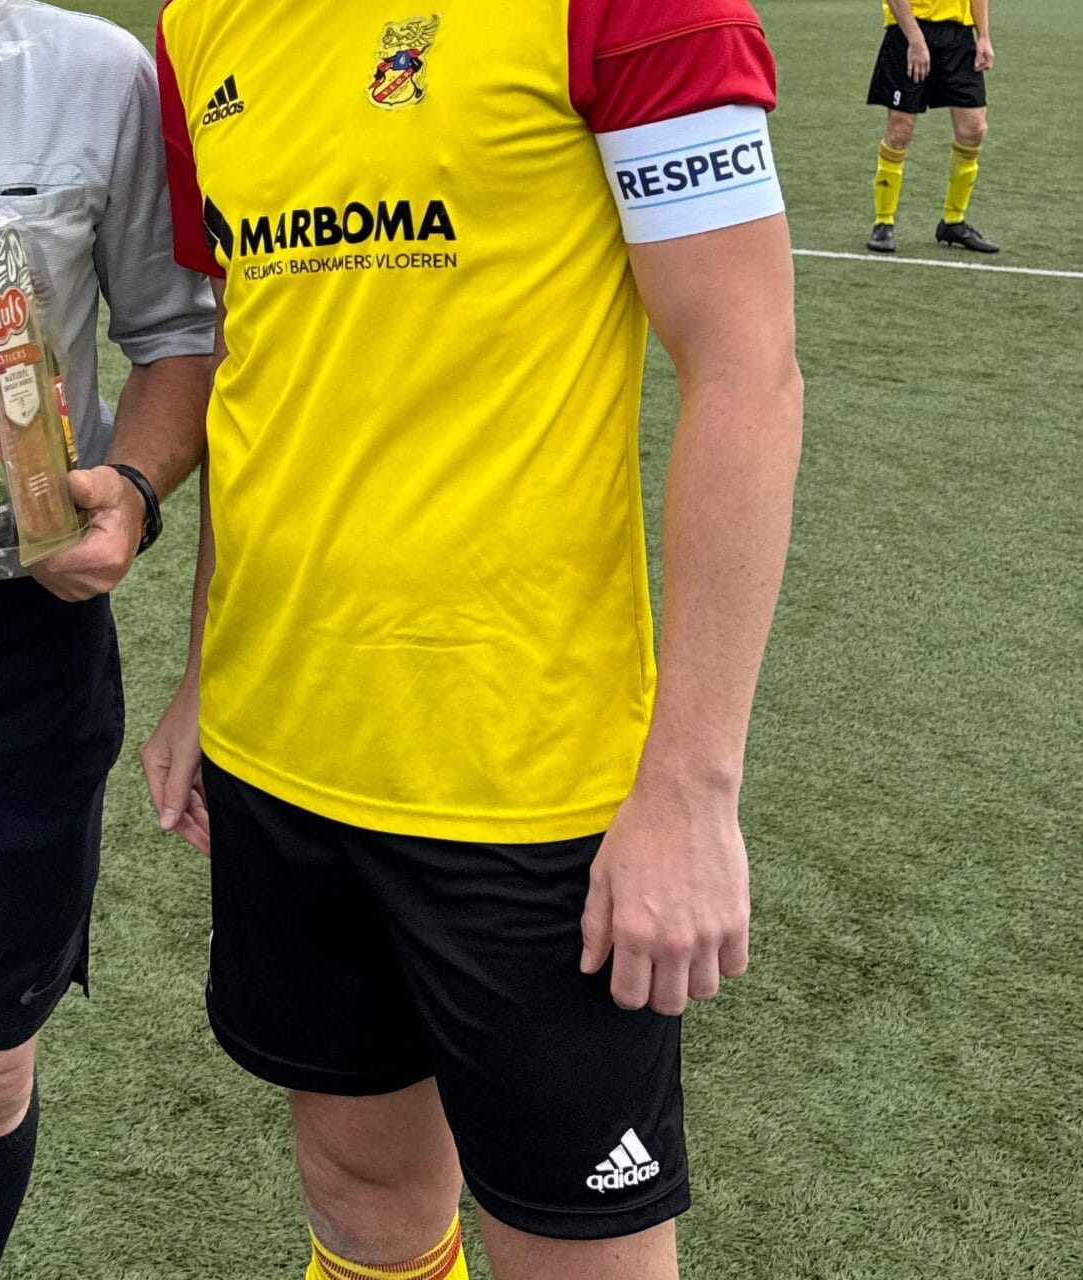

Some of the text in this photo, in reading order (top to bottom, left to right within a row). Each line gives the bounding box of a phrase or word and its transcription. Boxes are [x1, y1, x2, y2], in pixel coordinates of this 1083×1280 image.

[202, 100, 245, 126] adidas
[892, 90, 902, 106] 9
[616, 139, 767, 200] RESPECT
[240, 199, 457, 257] MARBOMA
[244, 252, 458, 281] KEUKNS BADKAMERS VLOEREN
[585, 1160, 661, 1194] adidas
